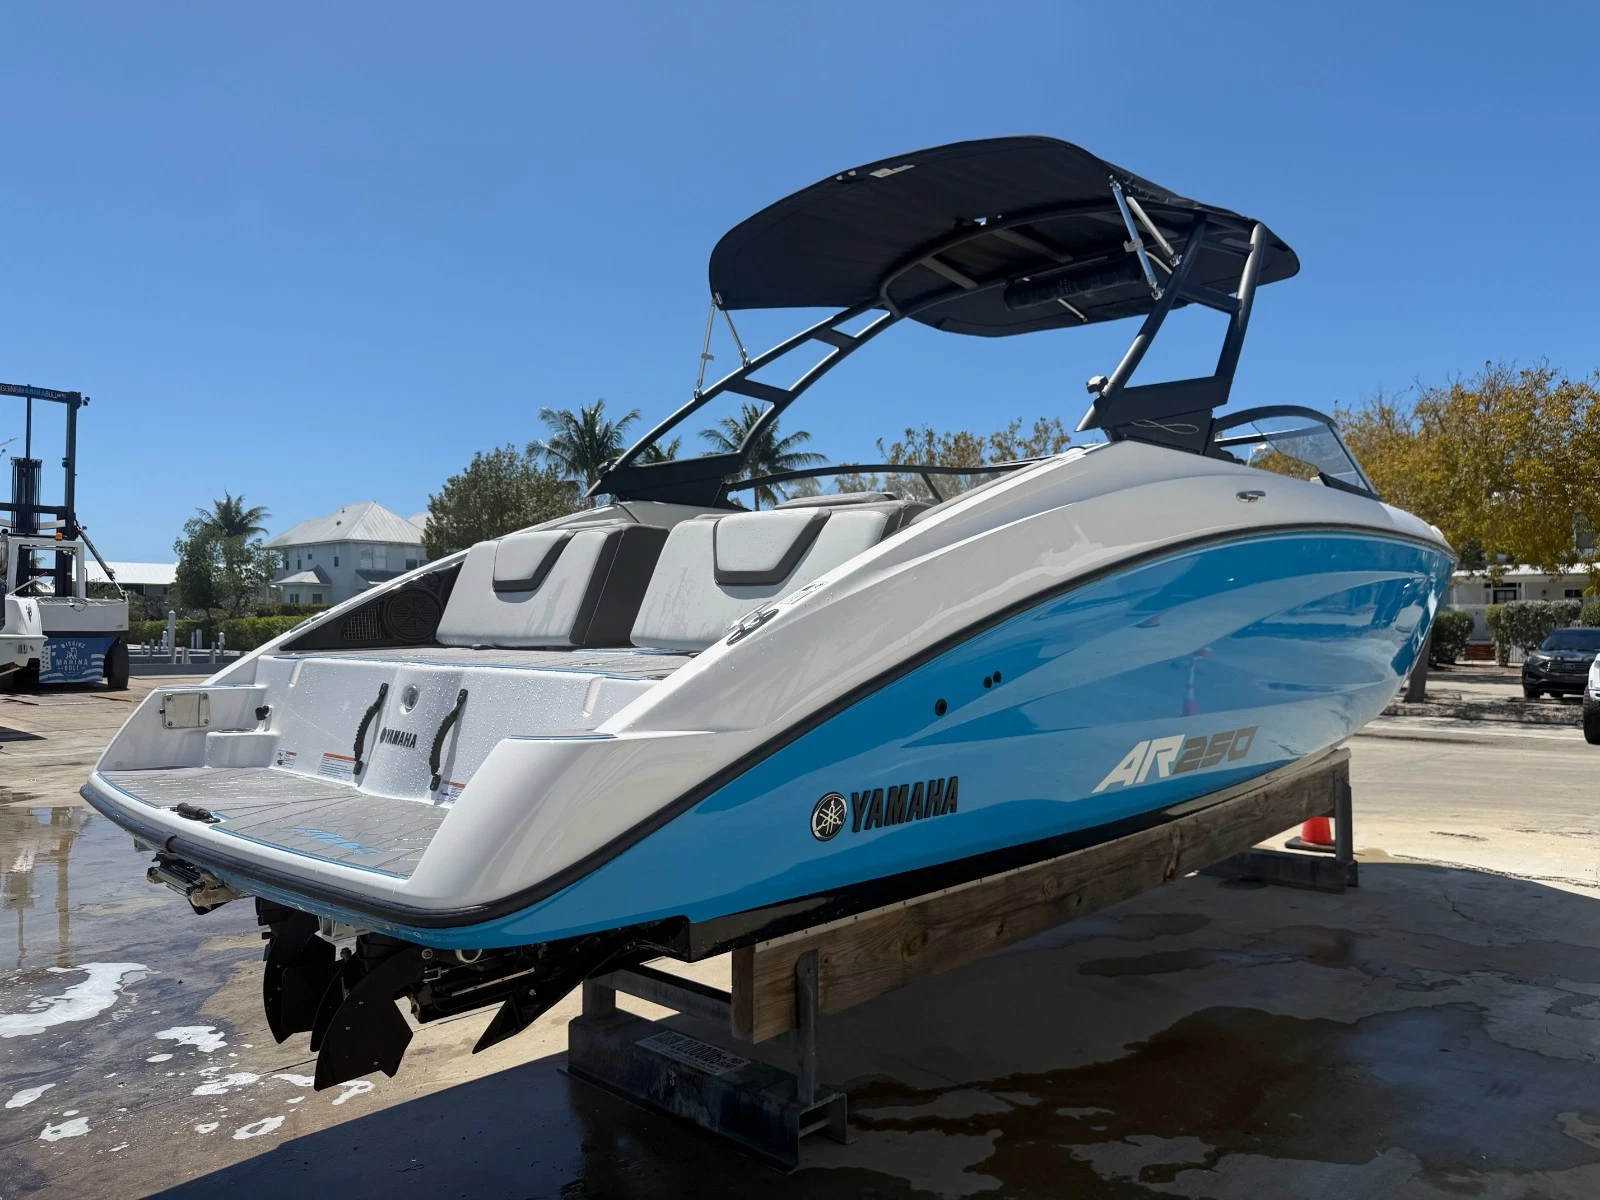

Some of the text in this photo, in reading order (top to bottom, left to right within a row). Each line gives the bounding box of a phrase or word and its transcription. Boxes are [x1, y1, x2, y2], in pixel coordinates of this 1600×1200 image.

[56, 658, 88, 666] MARINA
[385, 728, 418, 749] YAMAHA
[851, 775, 959, 833] YAMAHA
